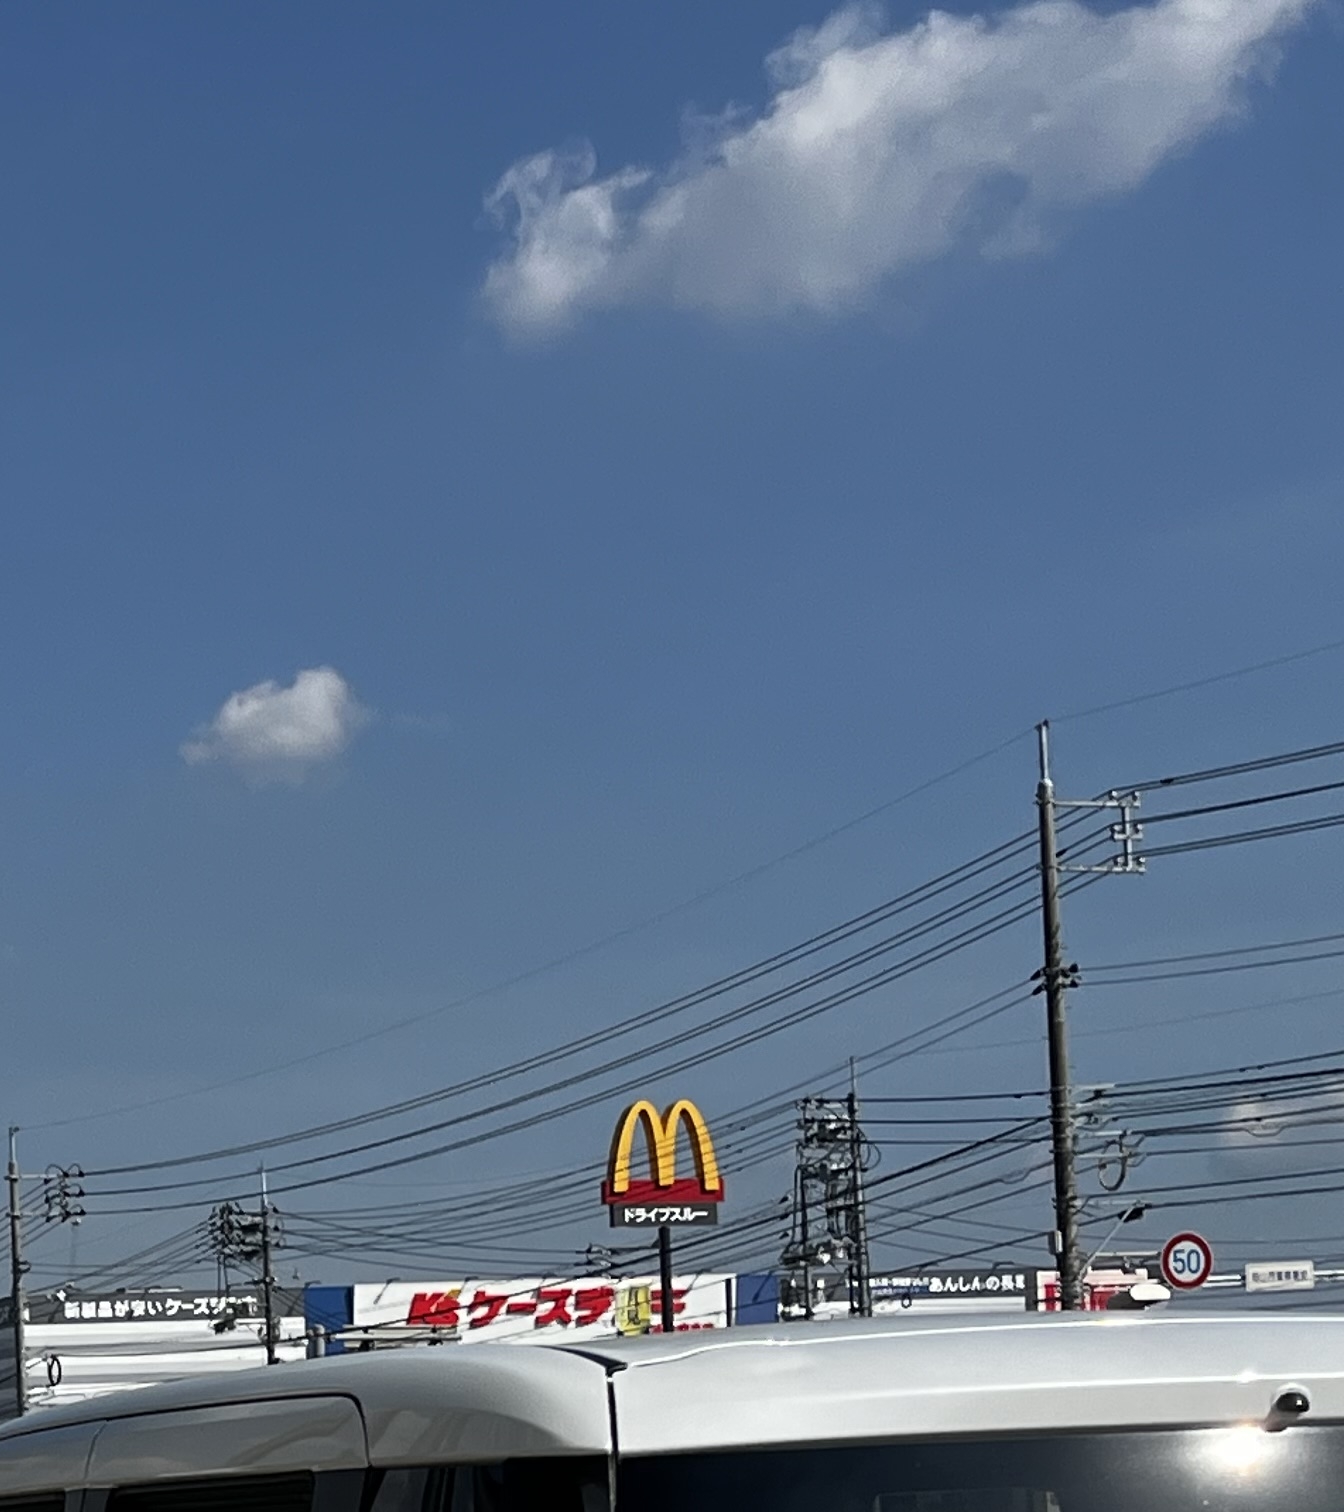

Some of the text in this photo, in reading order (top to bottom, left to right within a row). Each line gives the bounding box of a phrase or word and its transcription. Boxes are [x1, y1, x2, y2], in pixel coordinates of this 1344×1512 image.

[624, 1207, 708, 1222] ドライブスルー
[1172, 1250, 1201, 1274] 50
